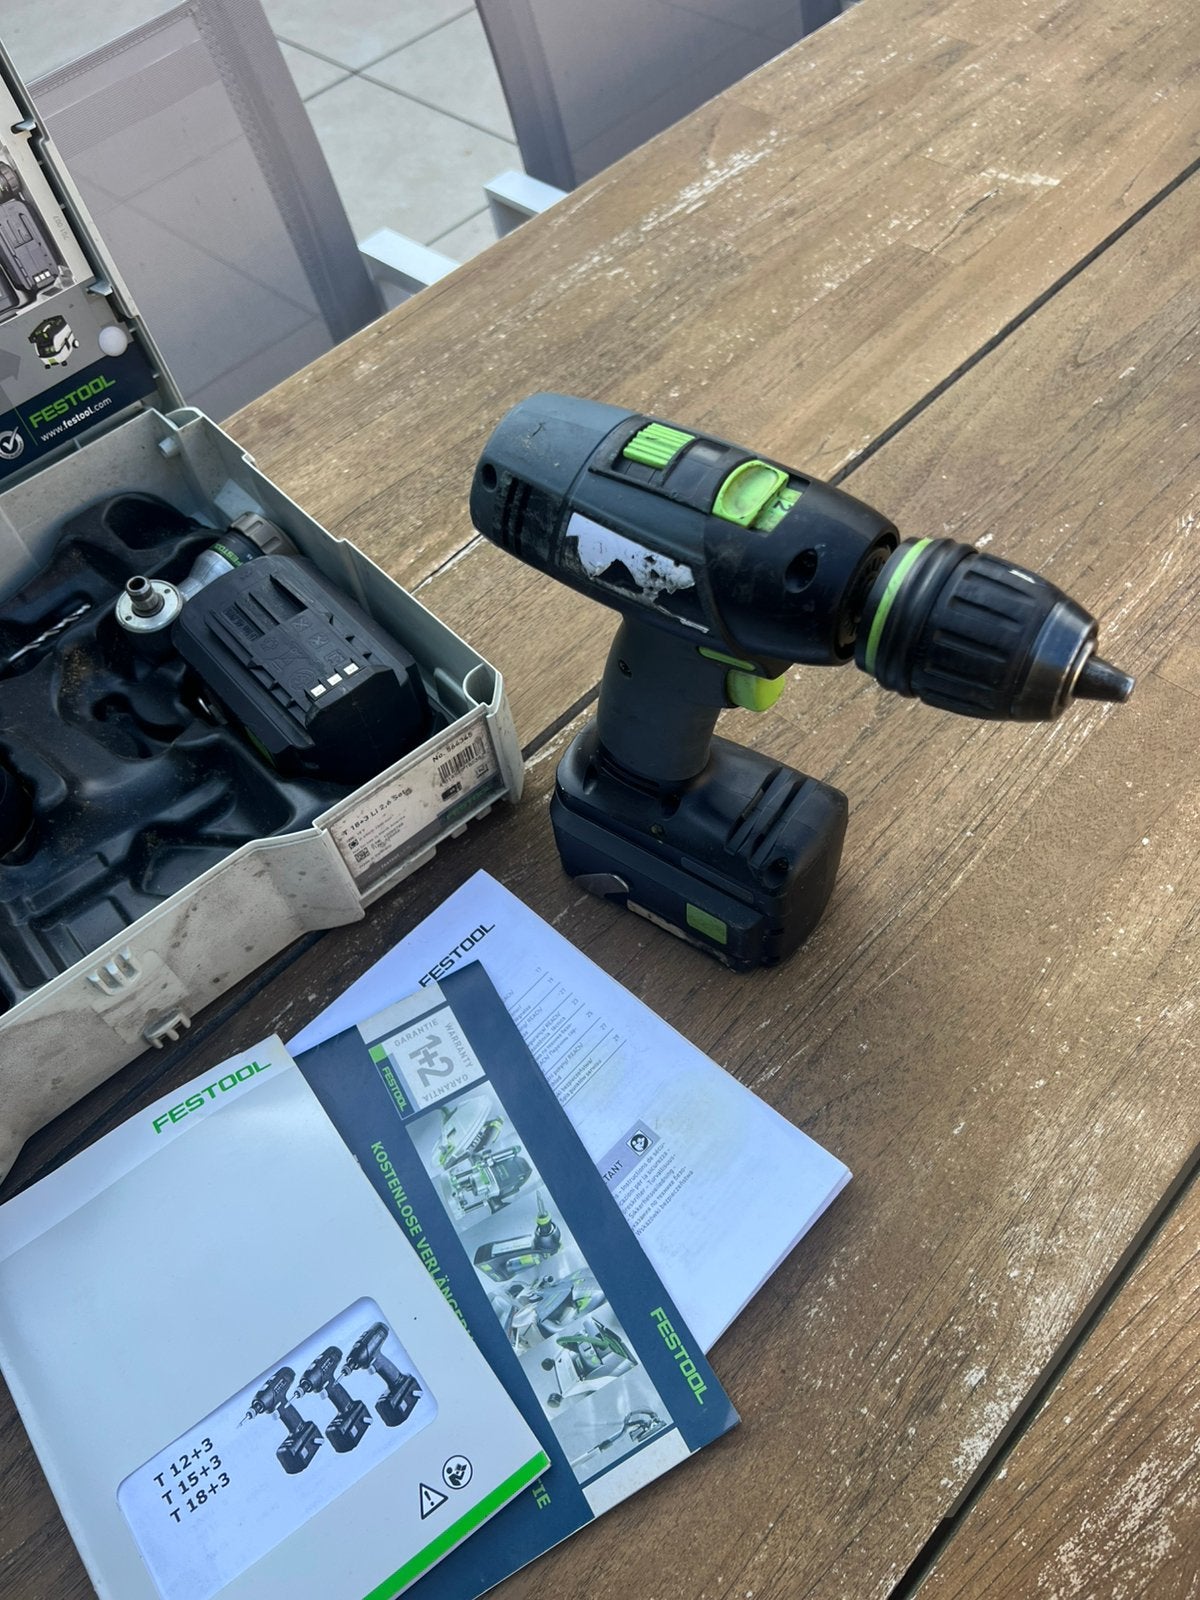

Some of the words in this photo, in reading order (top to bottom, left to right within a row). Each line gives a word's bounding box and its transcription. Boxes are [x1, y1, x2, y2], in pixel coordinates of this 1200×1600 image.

[27, 374, 116, 427] FESTOOL
[38, 395, 113, 442] www.festool.com
[431, 751, 446, 762] No.
[349, 814, 370, 830] 18+3
[418, 923, 495, 988] FESTOOL
[393, 1017, 438, 1047] GARANTIE
[443, 1022, 473, 1068] WARRANTY
[151, 1062, 271, 1133] FESTOOL
[381, 1065, 406, 1112] FESTOOL
[421, 1072, 469, 1103] GARANTIA
[372, 1142, 422, 1236] KOSTENLOSE
[602, 1159, 623, 1183] TANT
[649, 1306, 707, 1404] FESTOOL
[153, 1472, 164, 1486] T
[168, 1436, 213, 1477] 12+3
[161, 1489, 172, 1504] T
[176, 1454, 222, 1494] 15+3
[169, 1507, 180, 1522] T
[184, 1471, 231, 1512] 18+3
